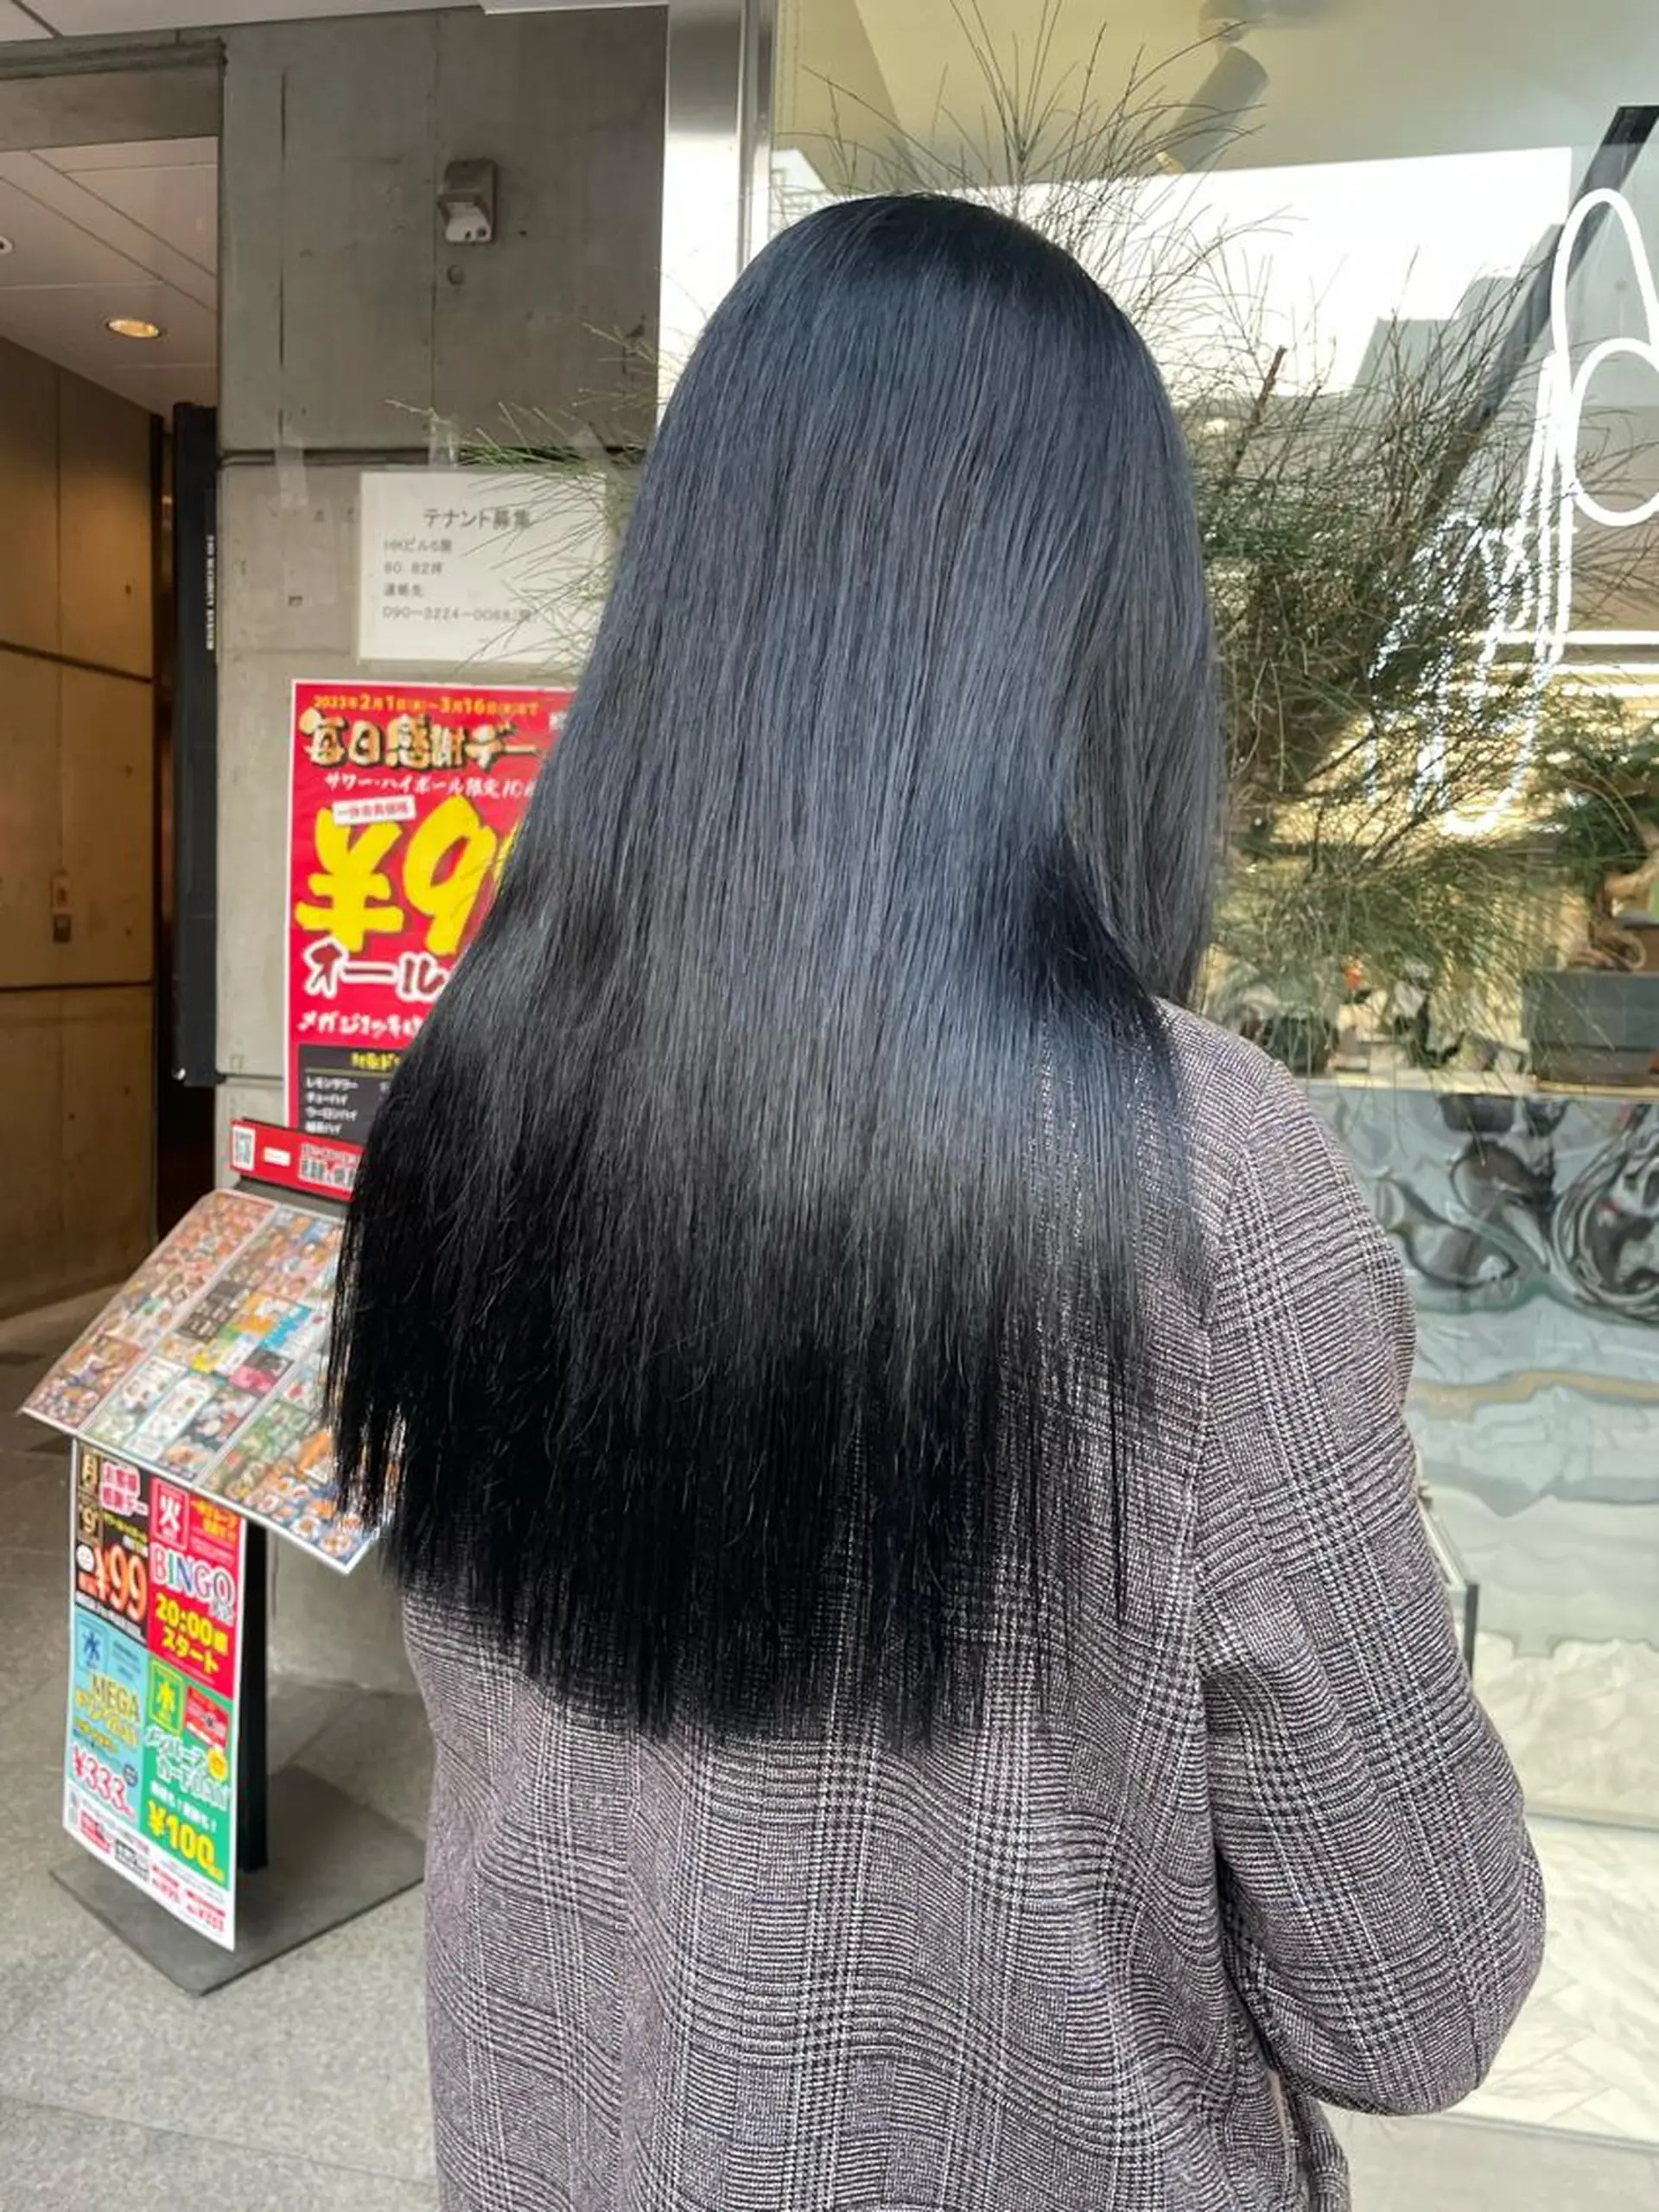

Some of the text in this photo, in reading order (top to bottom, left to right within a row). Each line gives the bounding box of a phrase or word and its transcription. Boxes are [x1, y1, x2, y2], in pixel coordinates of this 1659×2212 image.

[423, 508, 531, 530] テナント募集
[159, 1494, 181, 1533] 火
[150, 1541, 235, 1605] BINGO
[82, 1630, 101, 1661] 水
[162, 1626, 219, 1675] スタート
[147, 1799, 216, 1870] ¥100
